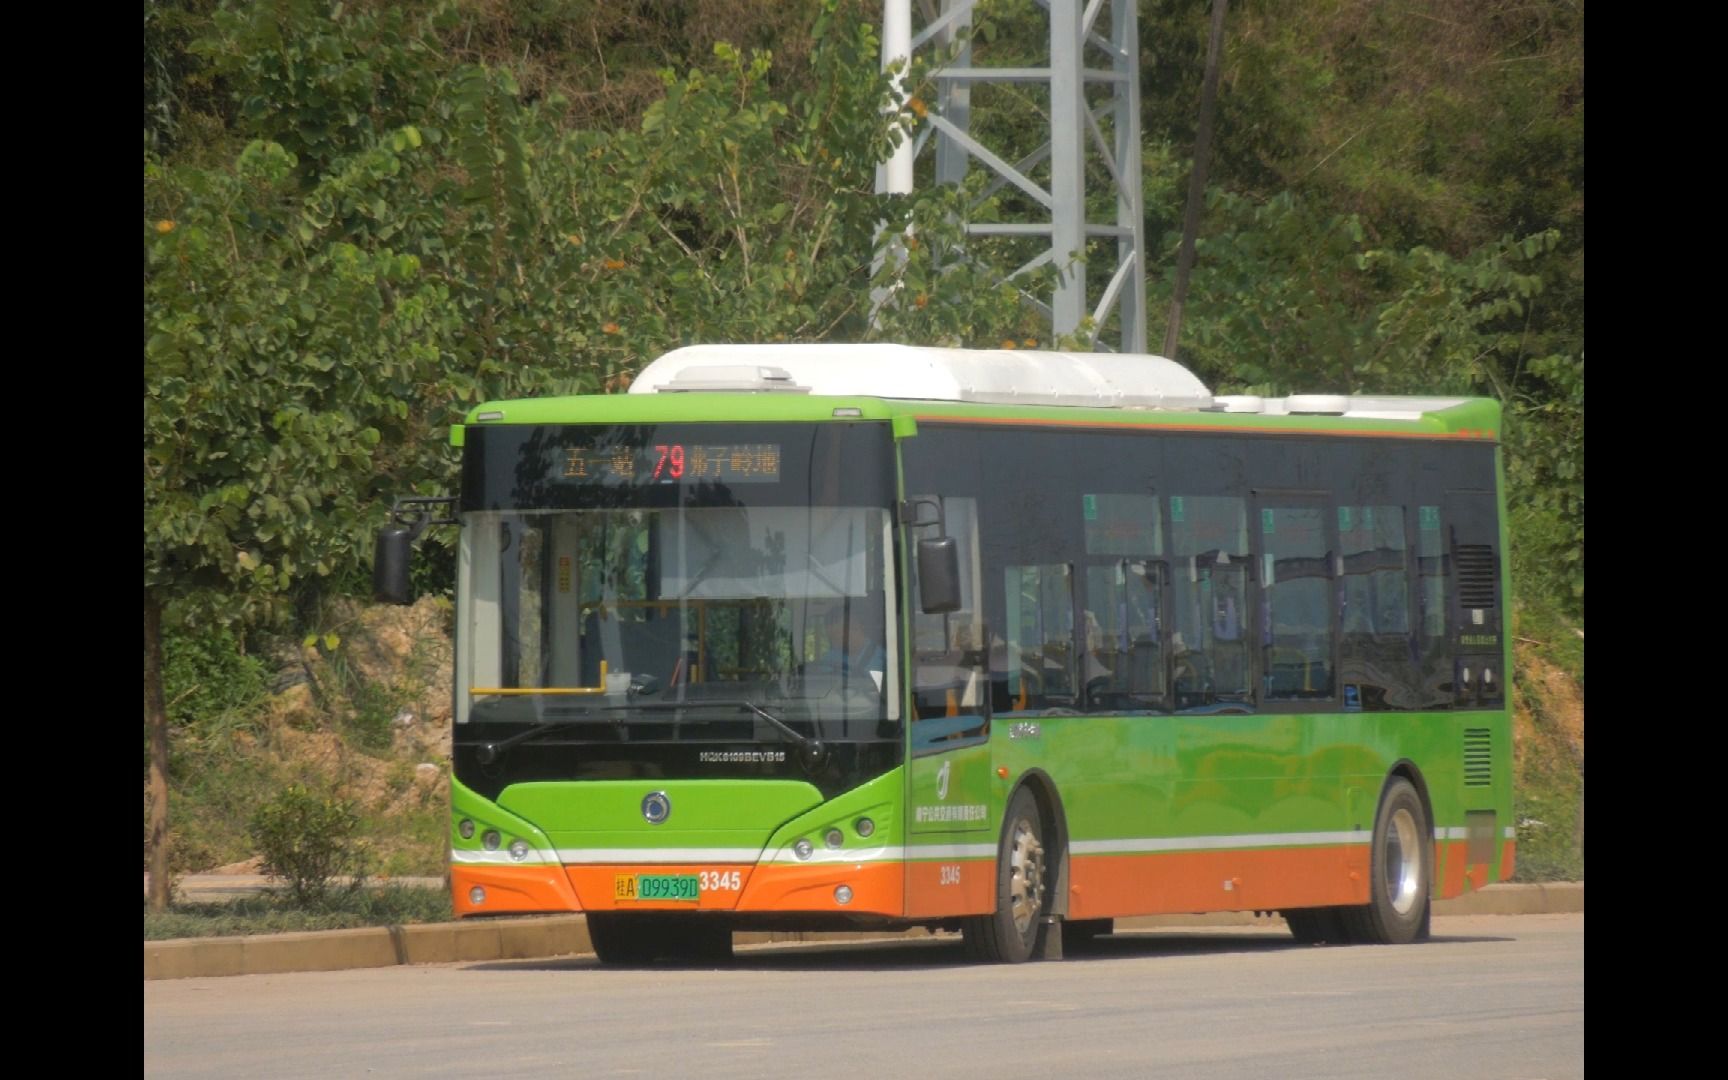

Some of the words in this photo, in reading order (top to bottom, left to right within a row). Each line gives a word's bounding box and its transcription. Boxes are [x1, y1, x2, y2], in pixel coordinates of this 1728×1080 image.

[563, 446, 635, 477] 五一站
[652, 445, 685, 480] 79
[700, 871, 741, 891] 3345
[939, 865, 961, 885] 3345
